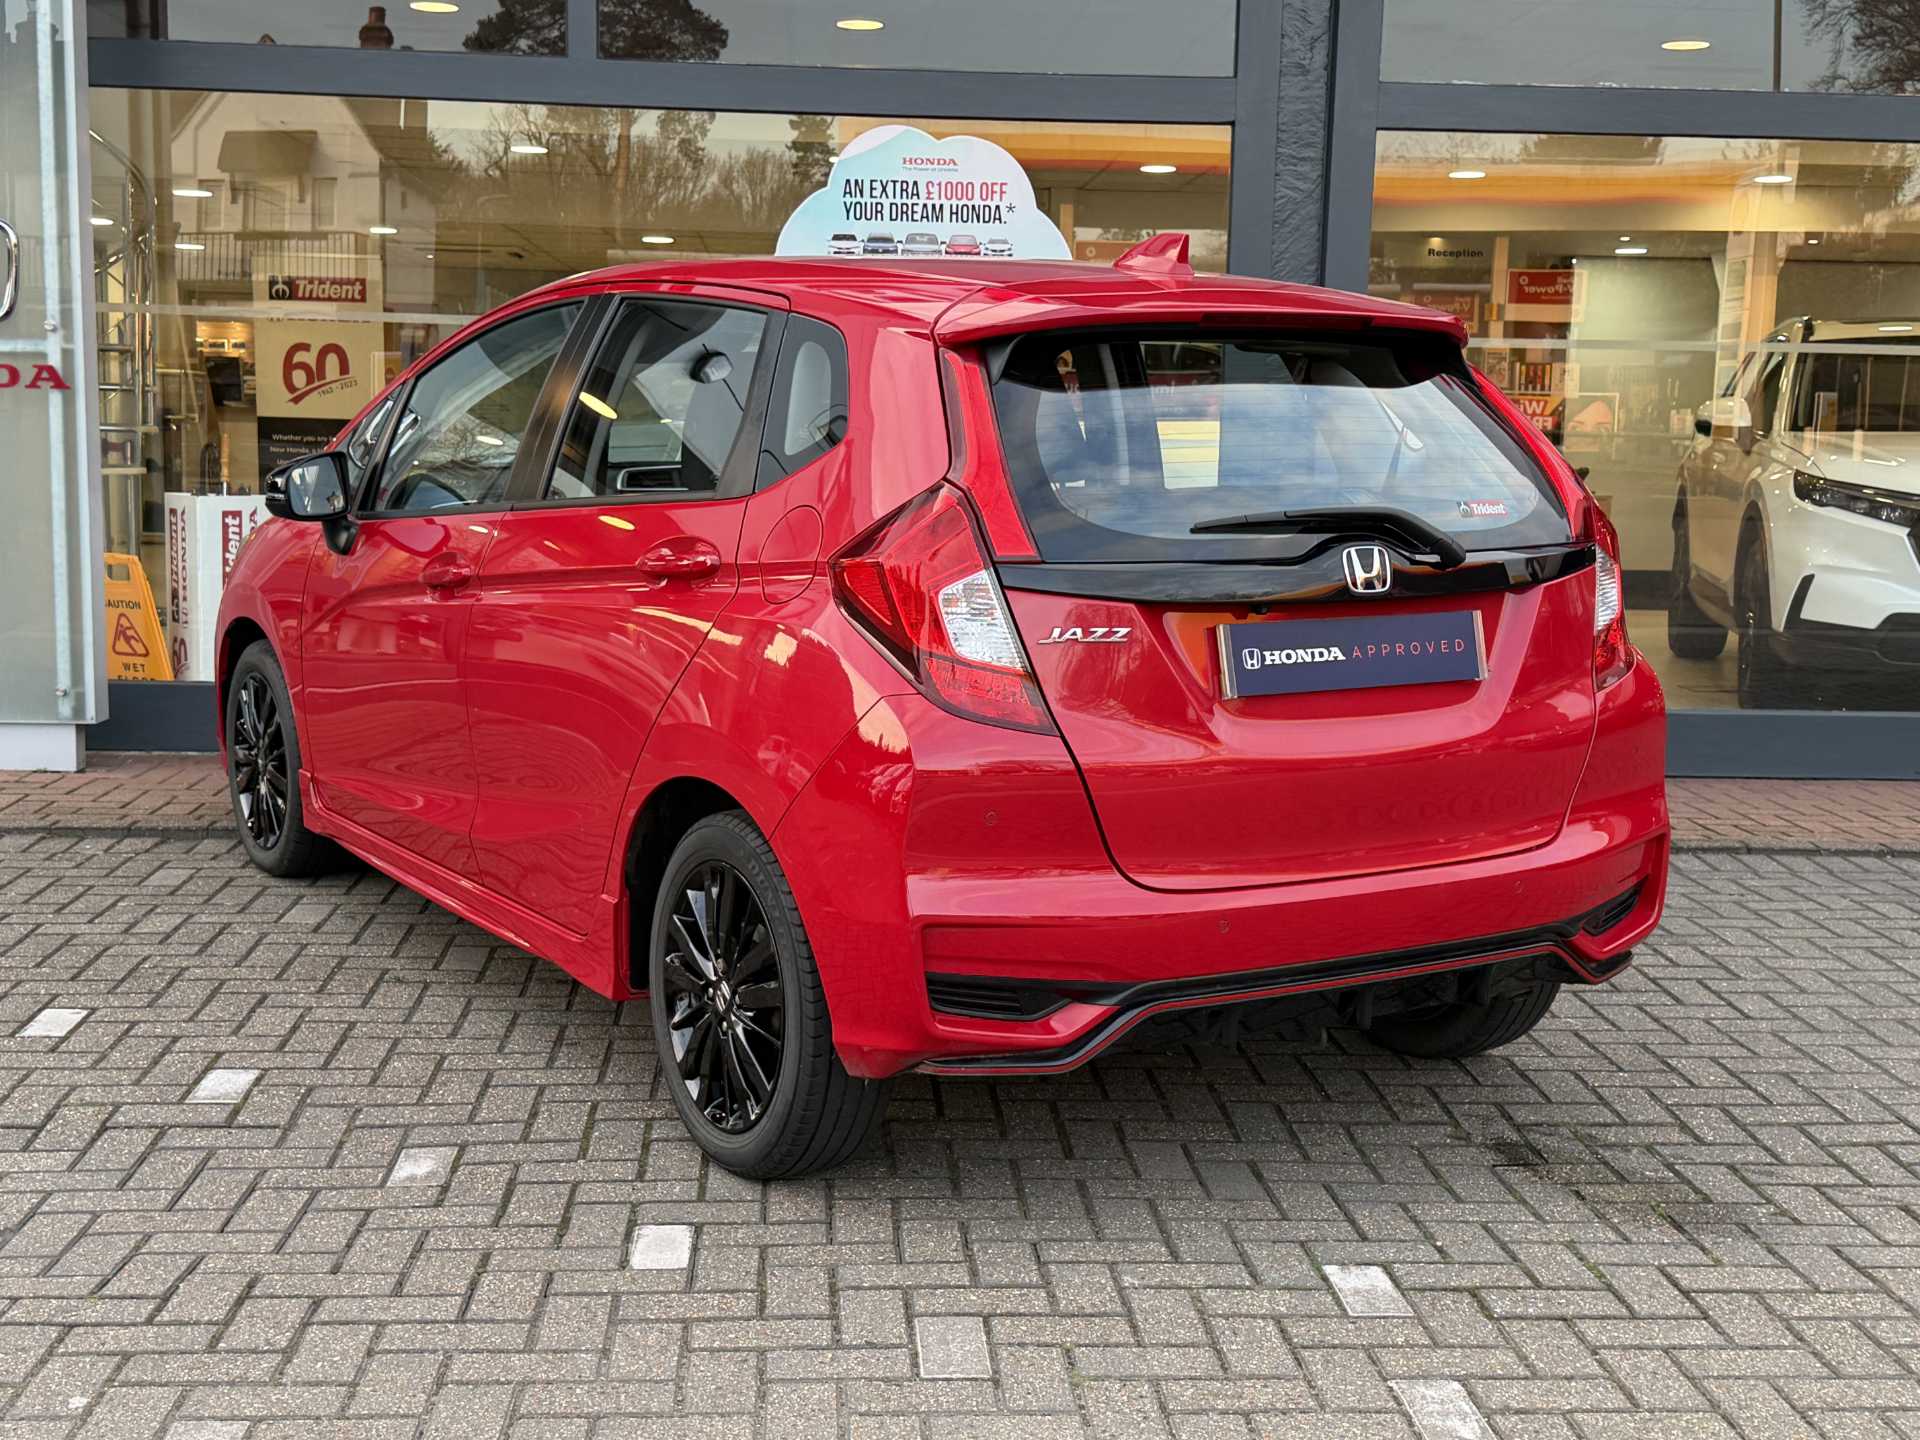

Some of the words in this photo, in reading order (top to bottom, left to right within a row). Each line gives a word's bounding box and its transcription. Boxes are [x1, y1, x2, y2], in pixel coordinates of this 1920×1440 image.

[902, 157, 959, 166] HONDA
[843, 178, 864, 199] AN
[869, 179, 921, 200] EXTRA
[925, 181, 975, 201] £1000
[979, 182, 1008, 202] OFF
[843, 201, 884, 222] YOUR
[889, 202, 944, 223] DREAM
[1427, 248, 1484, 259] Reception
[295, 279, 363, 300] Trident
[283, 342, 350, 394] 60
[1470, 503, 1506, 515] Trident
[105, 599, 142, 610] AUTION
[1037, 627, 1133, 645] JAZZ
[1263, 647, 1346, 666] HONDA
[1352, 638, 1465, 659] APPROVED
[121, 662, 145, 673] WET
